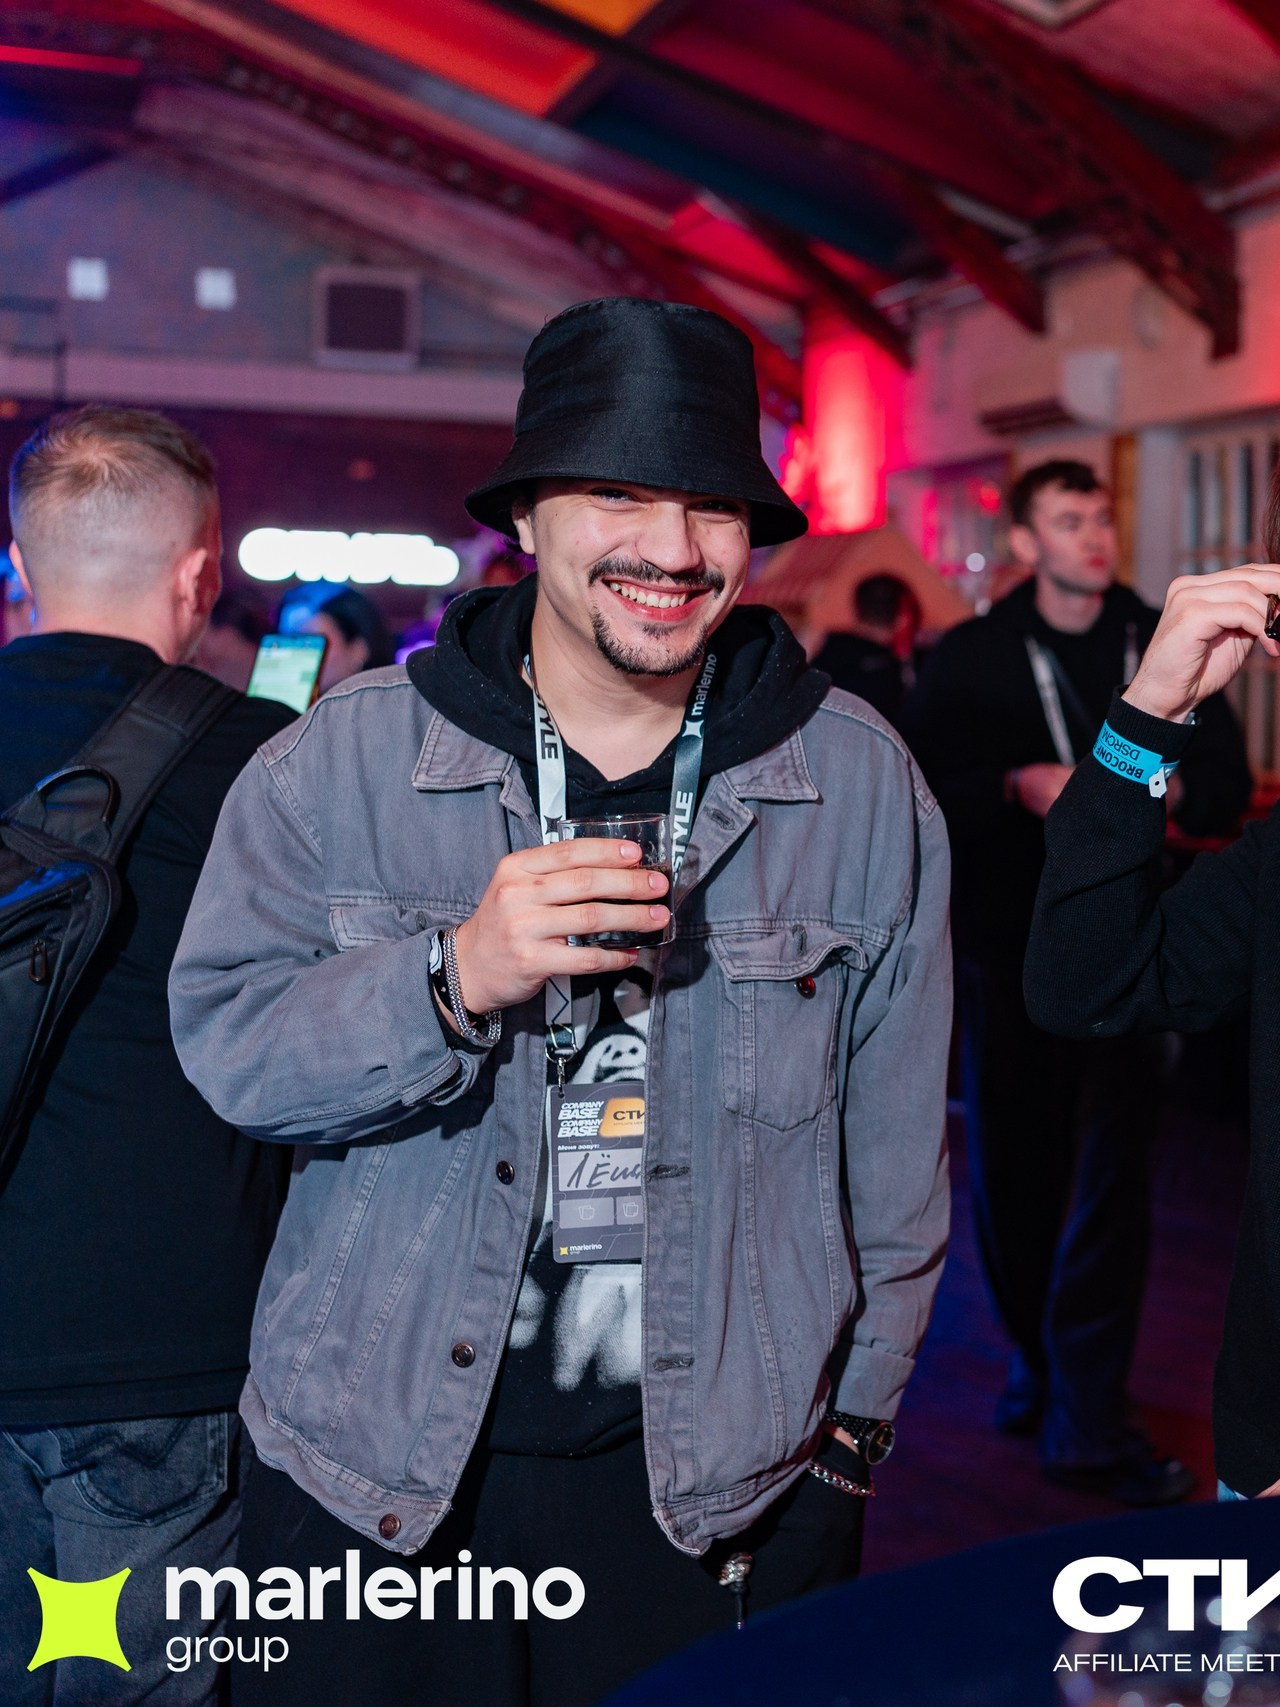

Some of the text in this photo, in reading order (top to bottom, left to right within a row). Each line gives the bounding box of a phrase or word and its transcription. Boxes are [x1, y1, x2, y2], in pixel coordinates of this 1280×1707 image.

[691, 653, 717, 717] marlerino
[535, 687, 559, 760] TYLE
[561, 1100, 604, 1110] COMPANY
[558, 1108, 600, 1120] BASE
[613, 1110, 645, 1121] СТИ
[560, 1119, 603, 1128] COMPANY
[557, 1126, 599, 1138] BASE
[569, 1242, 603, 1252] marlerino
